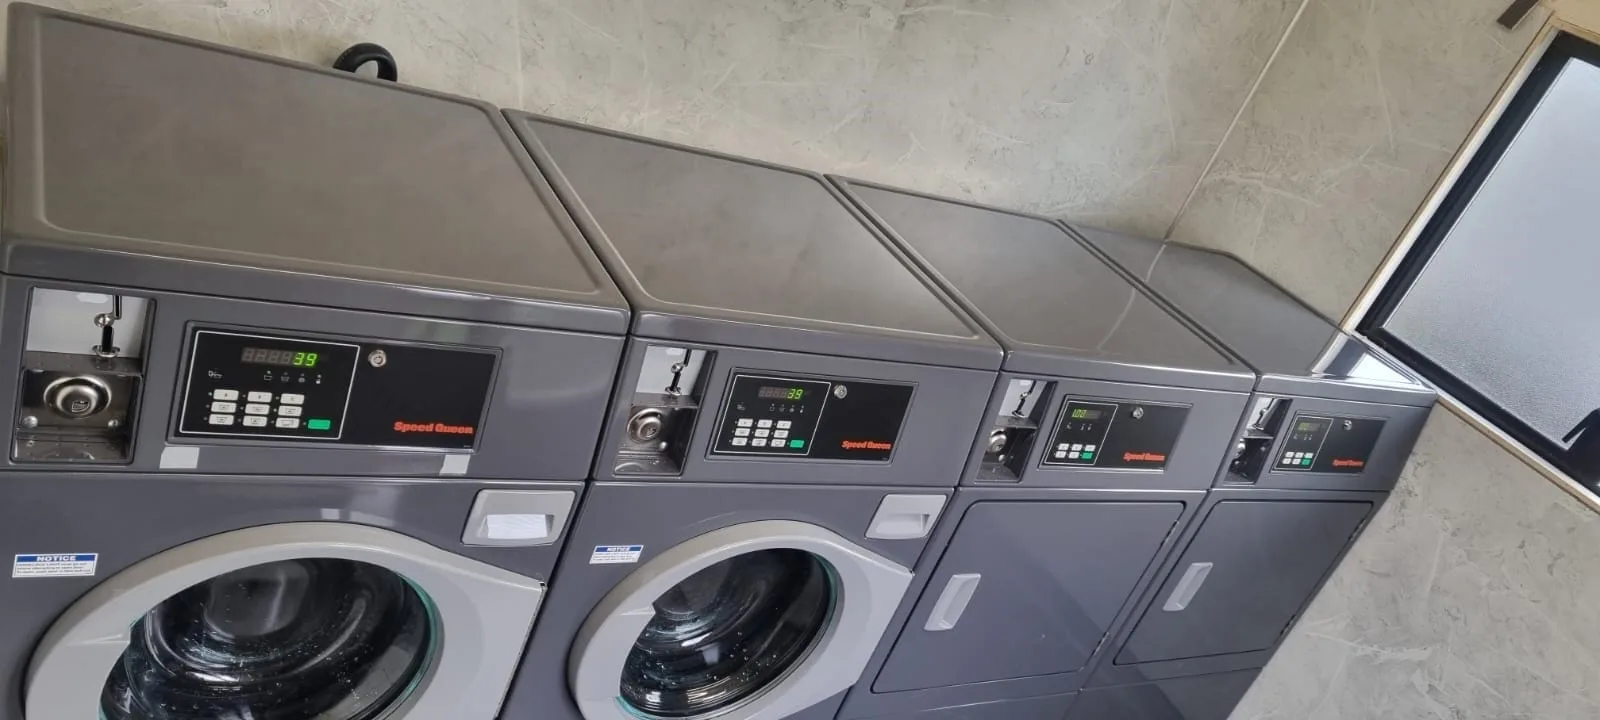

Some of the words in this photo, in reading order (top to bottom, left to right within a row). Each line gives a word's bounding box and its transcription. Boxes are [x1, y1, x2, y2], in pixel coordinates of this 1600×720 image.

[292, 352, 318, 367] 39
[787, 388, 804, 400] 39
[393, 421, 434, 433] Speed
[434, 423, 474, 434] Queen
[841, 440, 868, 450] Speed
[867, 441, 892, 450] Queen
[1123, 452, 1145, 462] Speed
[1144, 453, 1166, 461] Queen
